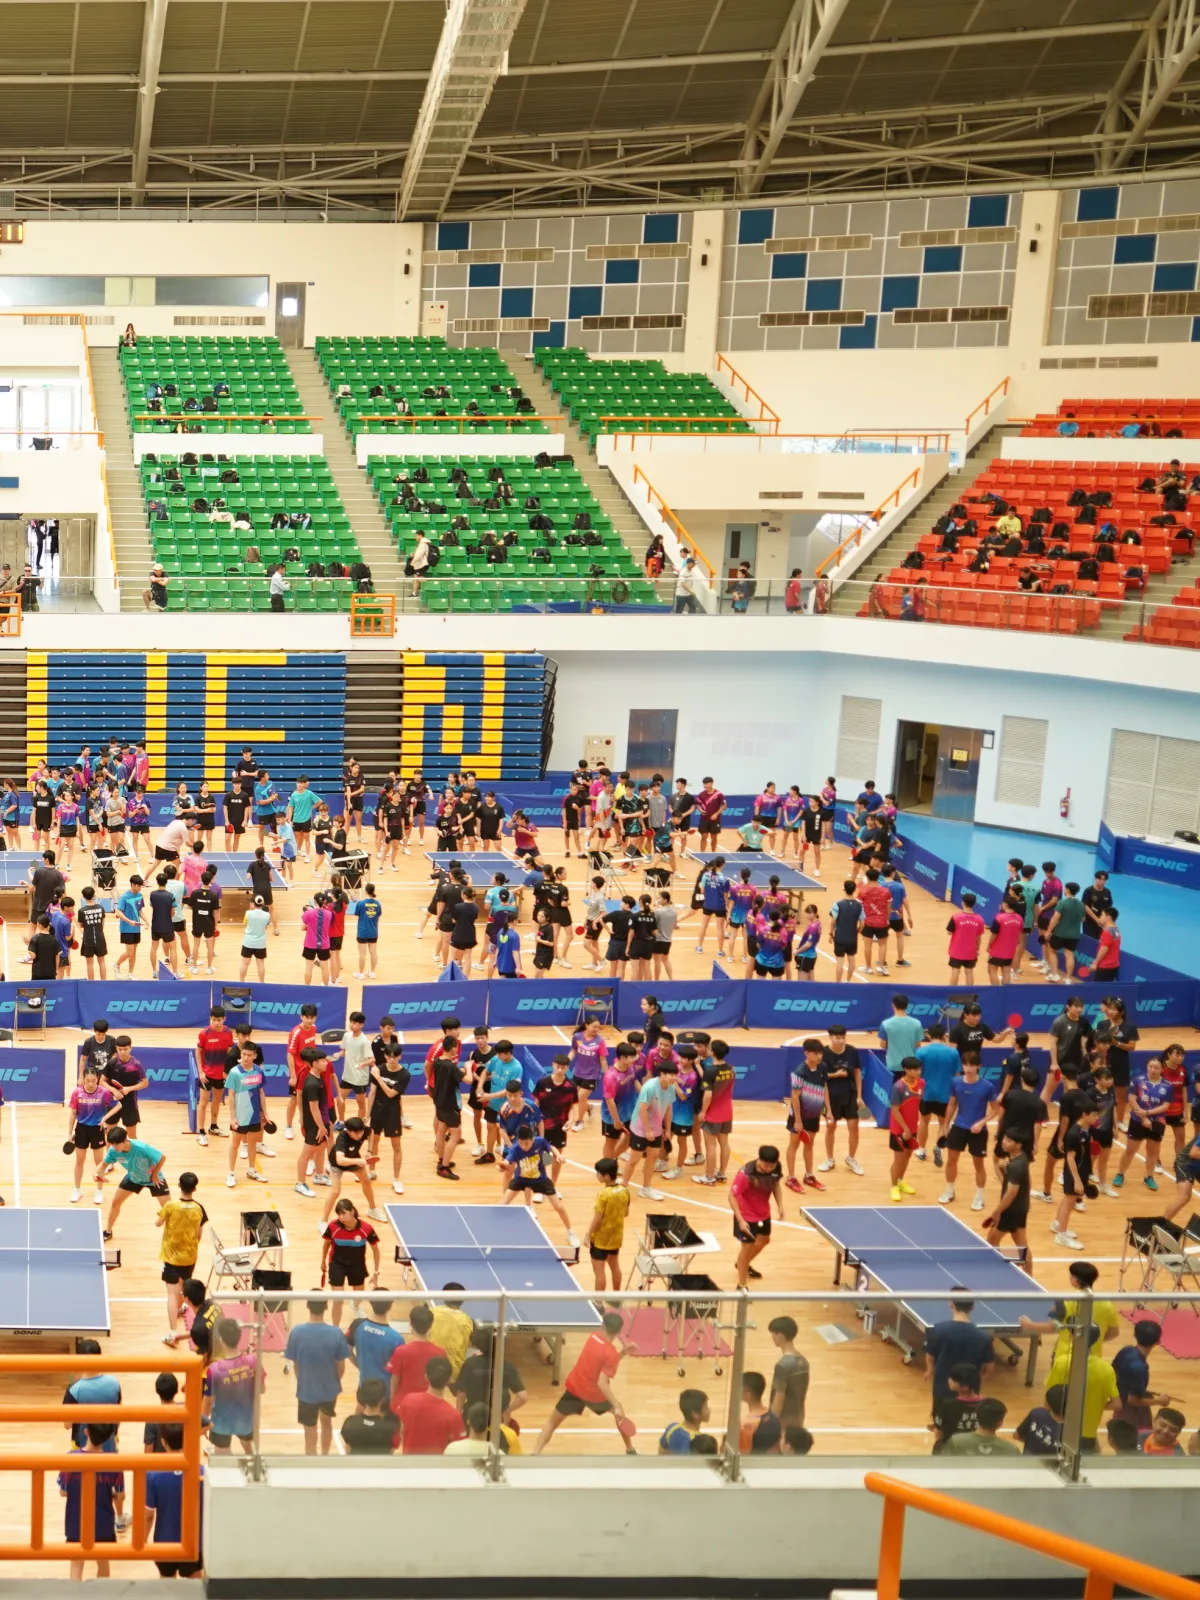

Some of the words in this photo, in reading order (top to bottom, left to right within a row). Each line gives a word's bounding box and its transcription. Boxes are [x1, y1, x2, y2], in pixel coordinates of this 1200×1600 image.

[523, 807, 563, 816] DONI
[914, 860, 939, 881] DONIC
[1134, 853, 1189, 873] DONIC
[106, 999, 181, 1013] DONIC
[250, 1001, 306, 1016] DONI
[388, 999, 459, 1015] DONIC
[658, 998, 718, 1013] ONIC
[774, 999, 851, 1014] DONIC
[146, 1069, 190, 1082] NIC
